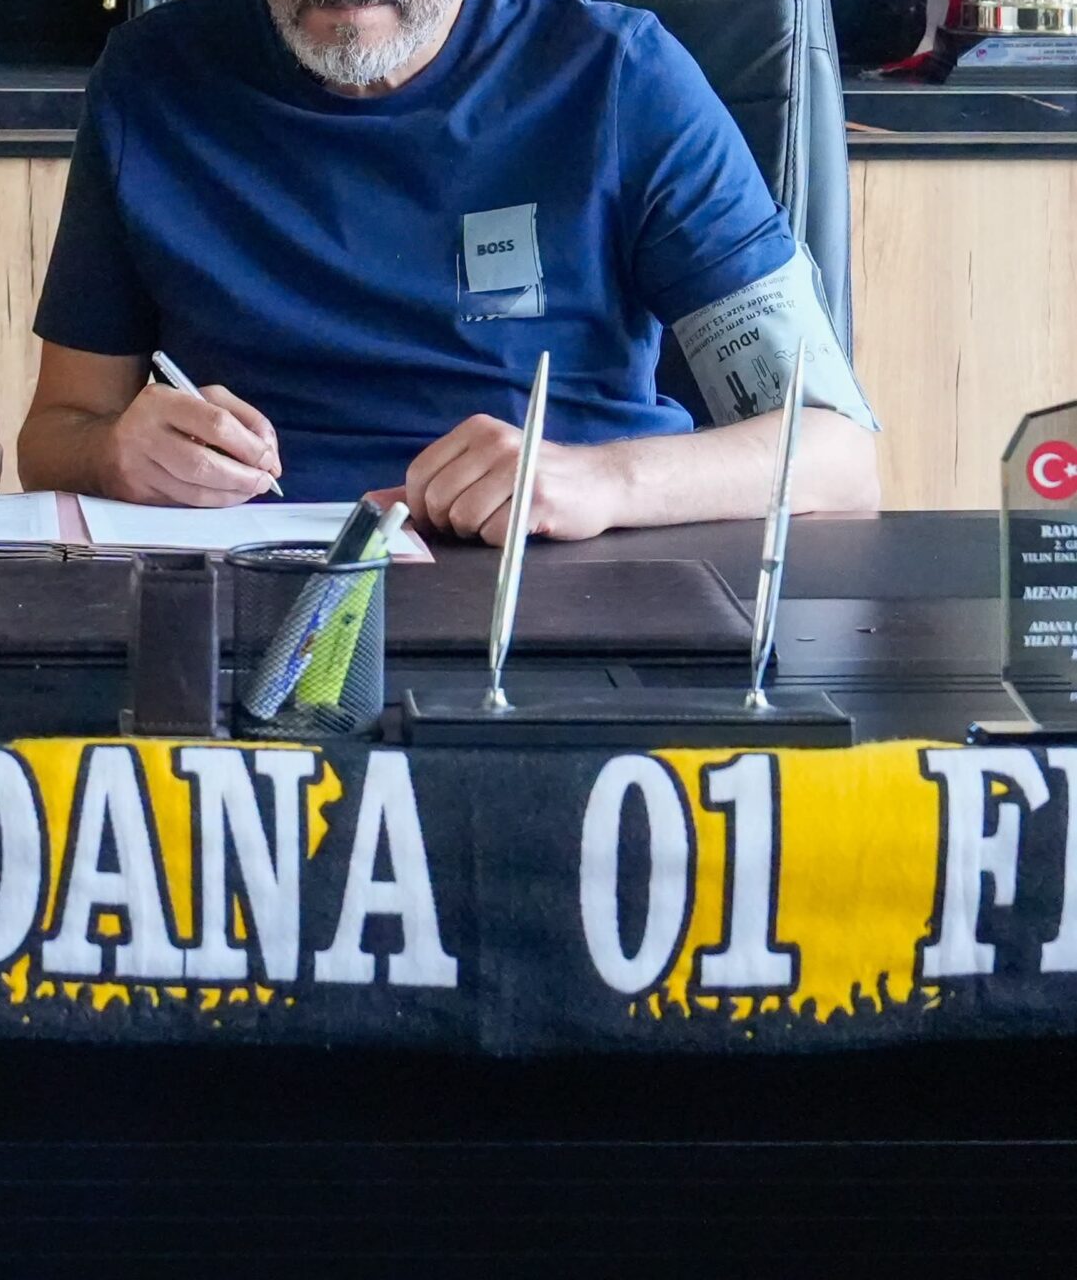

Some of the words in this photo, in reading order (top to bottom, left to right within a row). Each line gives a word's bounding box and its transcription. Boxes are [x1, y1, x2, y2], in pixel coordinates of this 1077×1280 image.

[477, 239, 515, 256] BOSS
[748, 290, 784, 307] Bladder
[746, 311, 761, 321] cm
[762, 304, 775, 315] 35
[726, 318, 745, 332] arm
[716, 326, 760, 362] ADULT
[1021, 552, 1053, 563] YILIN
[1028, 621, 1072, 632] ADANA
[1024, 635, 1060, 648] YILIN
[579, 752, 795, 995] 01
